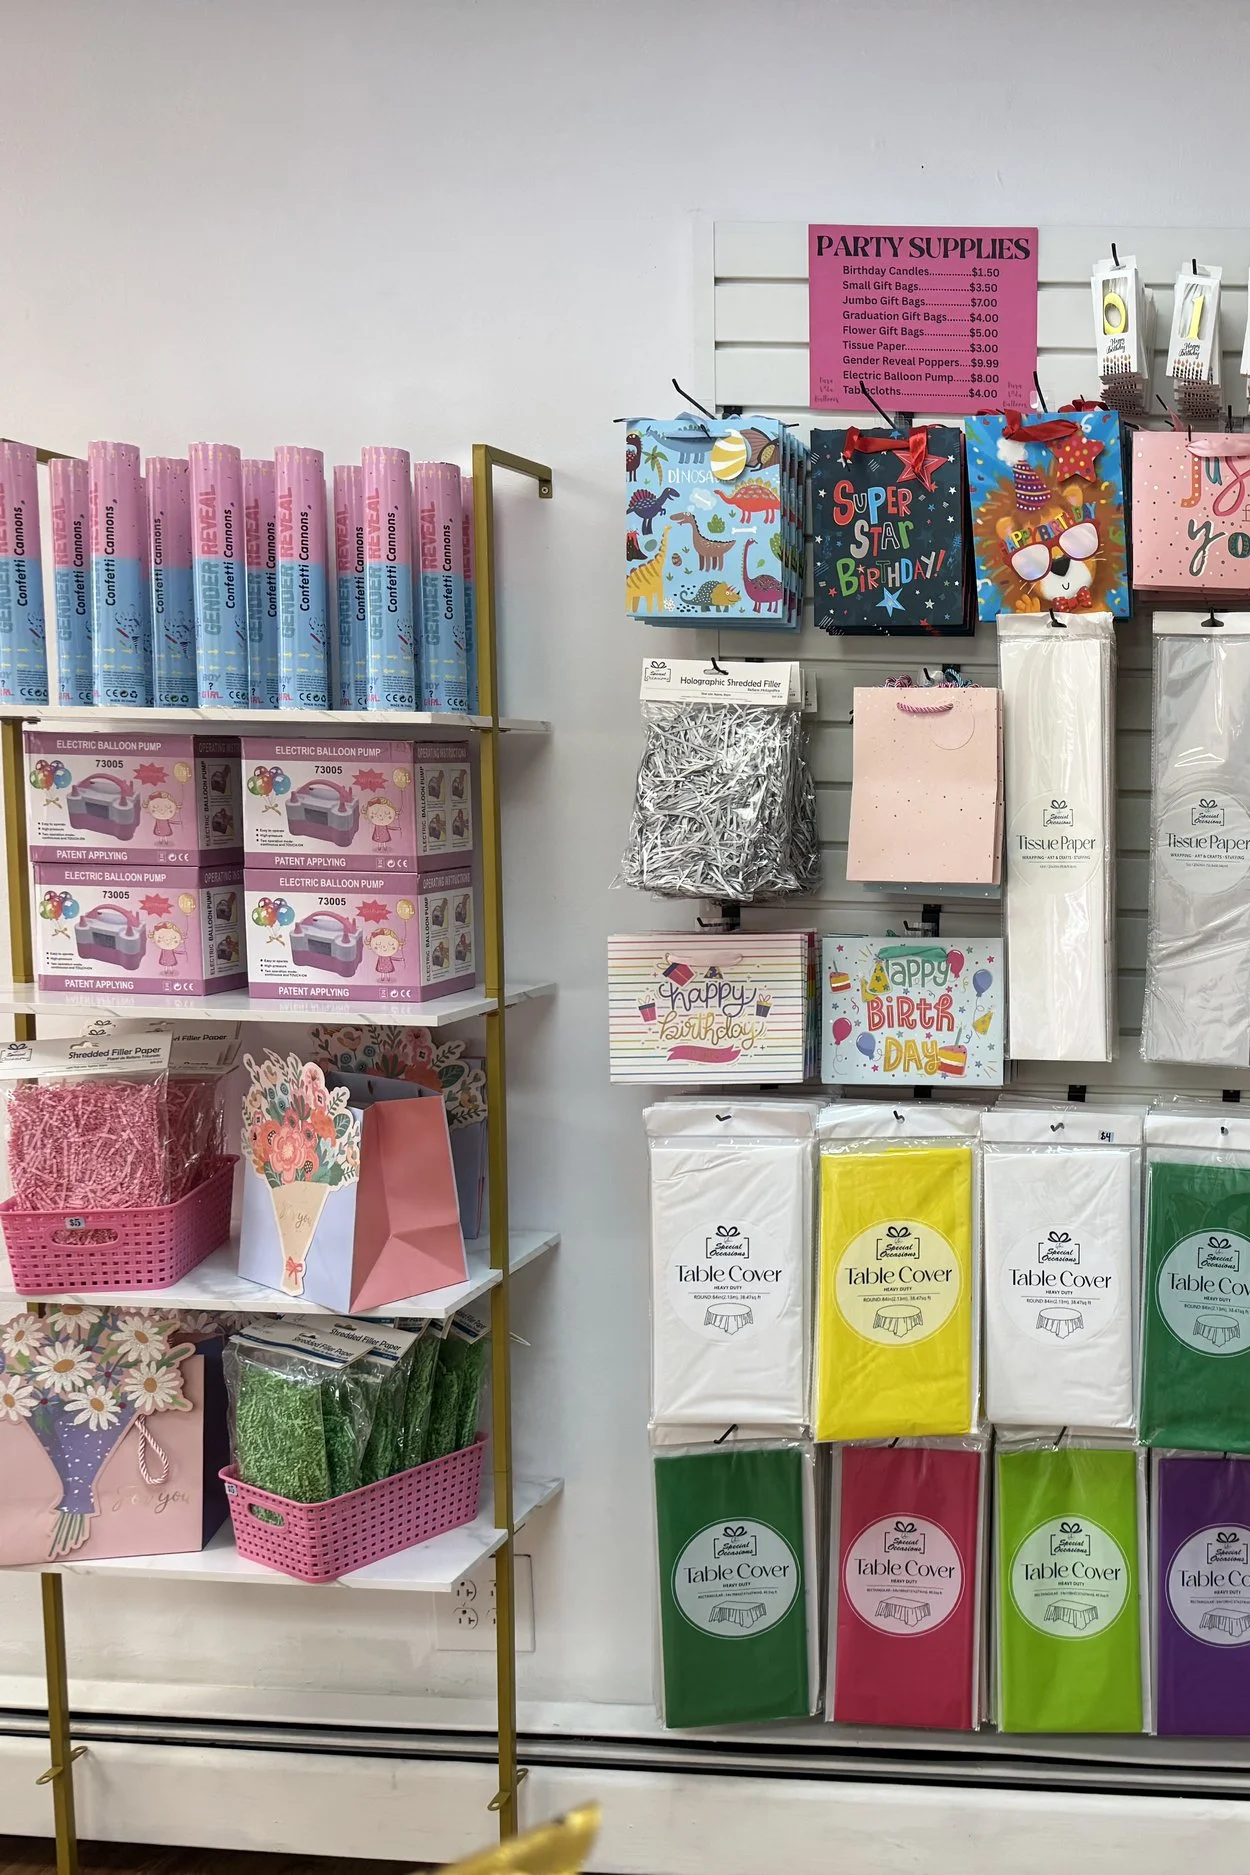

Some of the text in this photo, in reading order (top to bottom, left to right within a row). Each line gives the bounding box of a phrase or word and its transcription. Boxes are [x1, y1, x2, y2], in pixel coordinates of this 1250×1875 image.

[817, 235, 1030, 260] PARTY SUPPLIES
[843, 266, 1000, 277] Birthday Candles $1.50
[843, 281, 998, 293] Small Gift Bags $3.50
[843, 296, 997, 308] Jumbo Gift Bags $7.00
[843, 311, 998, 323] Graduation Gift Bags $4.00
[1104, 292, 1126, 335] 0
[1188, 295, 1204, 340] 1
[843, 326, 998, 338] Flower Gift Bags $5.00
[843, 341, 998, 353] Tissue Paper $3.00
[843, 356, 999, 369] Gender Reveal Poppers $9.99
[843, 371, 999, 383] Electric Balloon Pump $8.00
[968, 389, 998, 399] $4.00
[668, 467, 727, 483] DINOSA
[199, 484, 221, 636] GENDER REVEAL
[224, 510, 235, 609] Confetti Cannons
[680, 677, 781, 688] Holographic Shredded Filler
[1017, 835, 1096, 853] Tissue Paper
[279, 878, 384, 889] ELECTRIC BALLOON PUMP
[318, 897, 347, 906] 73005
[279, 987, 349, 997] PATENT APPLYING
[658, 982, 757, 1018] happy
[658, 1011, 765, 1049] birthday
[68, 1049, 110, 1059] Shredded
[111, 1048, 132, 1057] Filler
[135, 1046, 161, 1056] Paper
[883, 1037, 941, 1074] DAY
[674, 1264, 782, 1282] Table Cover
[1168, 1272, 1215, 1292] Table
[329, 1328, 402, 1353] Shredded Filler Paper
[854, 1558, 956, 1578] Table Cover
